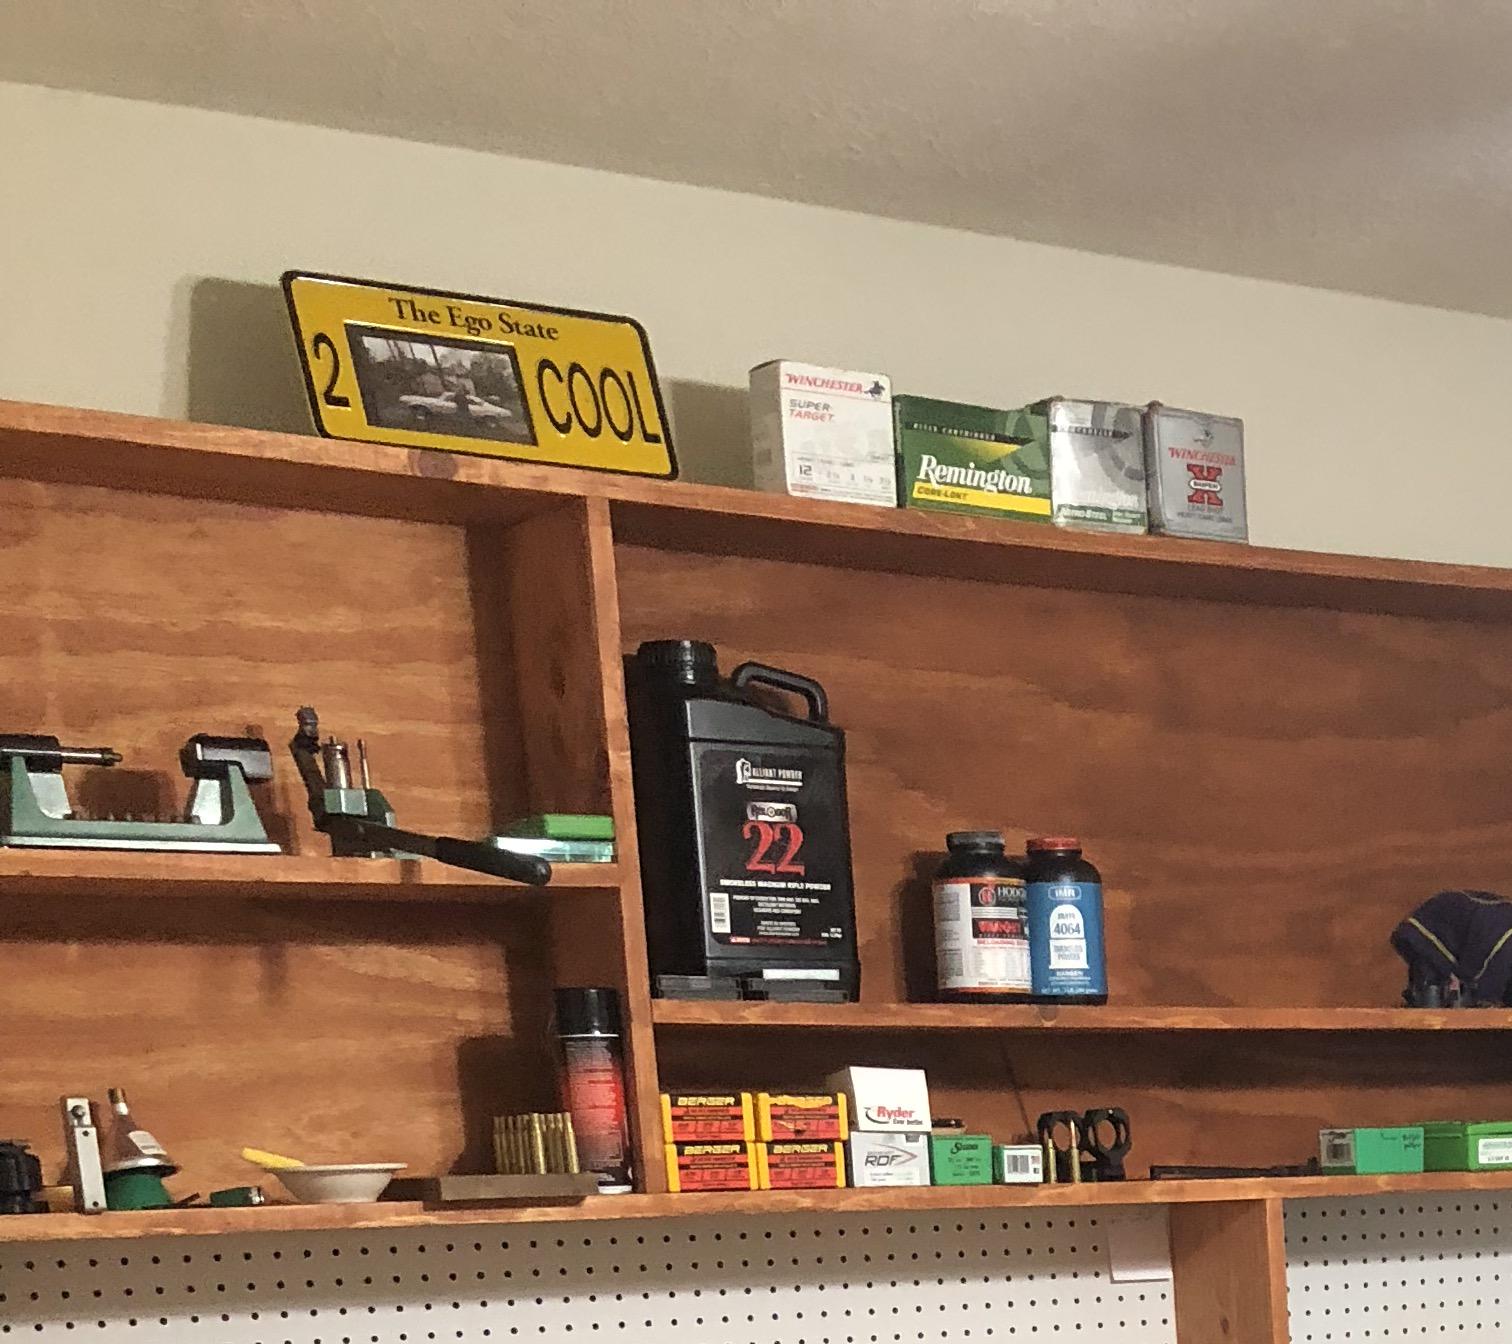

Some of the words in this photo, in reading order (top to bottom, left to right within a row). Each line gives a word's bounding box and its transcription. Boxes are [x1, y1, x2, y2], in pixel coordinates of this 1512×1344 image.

[388, 297, 441, 325] The
[446, 305, 493, 337] Ego
[498, 312, 559, 341] State
[312, 332, 351, 408] 2
[785, 373, 864, 393] WINCHESTER
[537, 358, 662, 444] COOL
[789, 398, 831, 412] SUPER
[789, 409, 834, 422] TARGET
[1168, 447, 1236, 466] WINCHESTER
[799, 464, 813, 476] 12
[916, 454, 1033, 495] Remington
[1186, 463, 1223, 507] X
[741, 821, 806, 877] 22
[997, 886, 1027, 898] HODG
[1053, 921, 1081, 936] 4064
[677, 1096, 736, 1107] BERGER
[877, 1105, 916, 1120] Ryder
[684, 1144, 741, 1155] BERGER
[773, 1144, 829, 1154] BERGER
[865, 1154, 901, 1167] RDF
